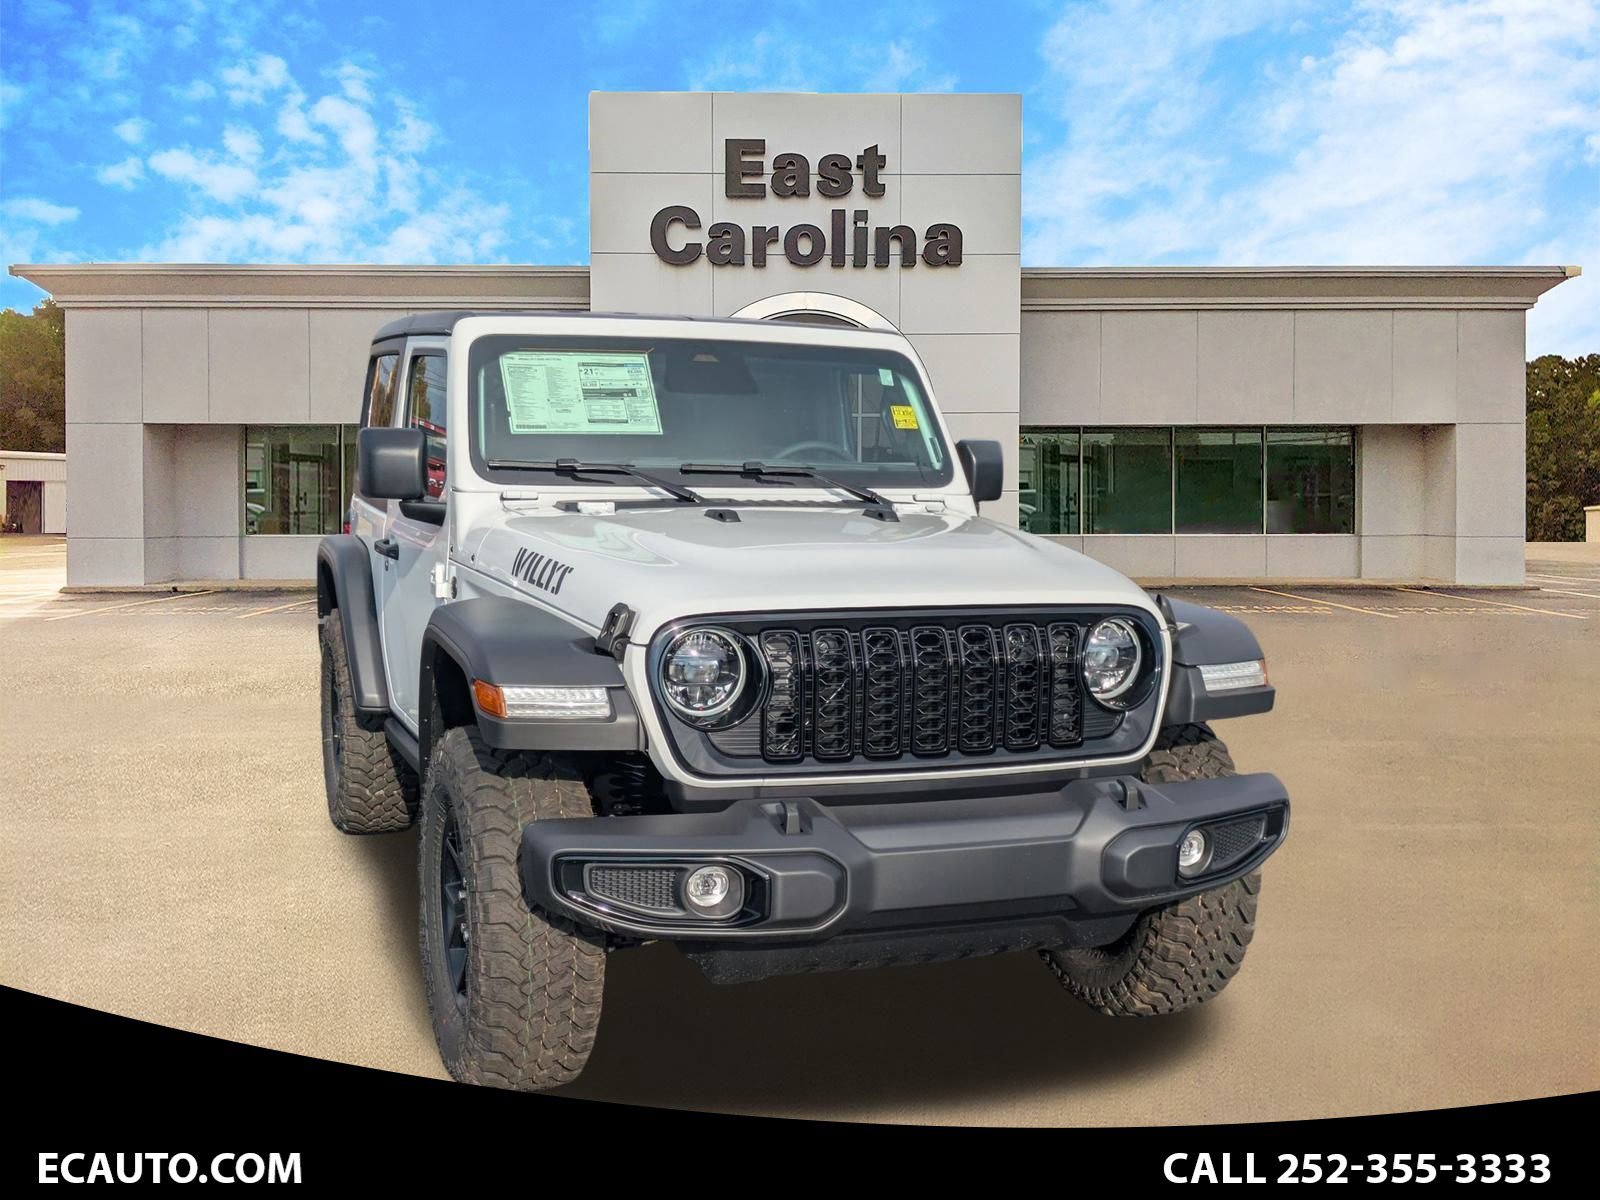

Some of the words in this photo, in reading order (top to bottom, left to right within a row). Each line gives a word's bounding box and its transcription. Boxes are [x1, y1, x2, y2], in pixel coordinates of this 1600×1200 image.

[725, 138, 887, 199] East
[650, 205, 963, 268] Carolina
[511, 546, 574, 595] WILLYS
